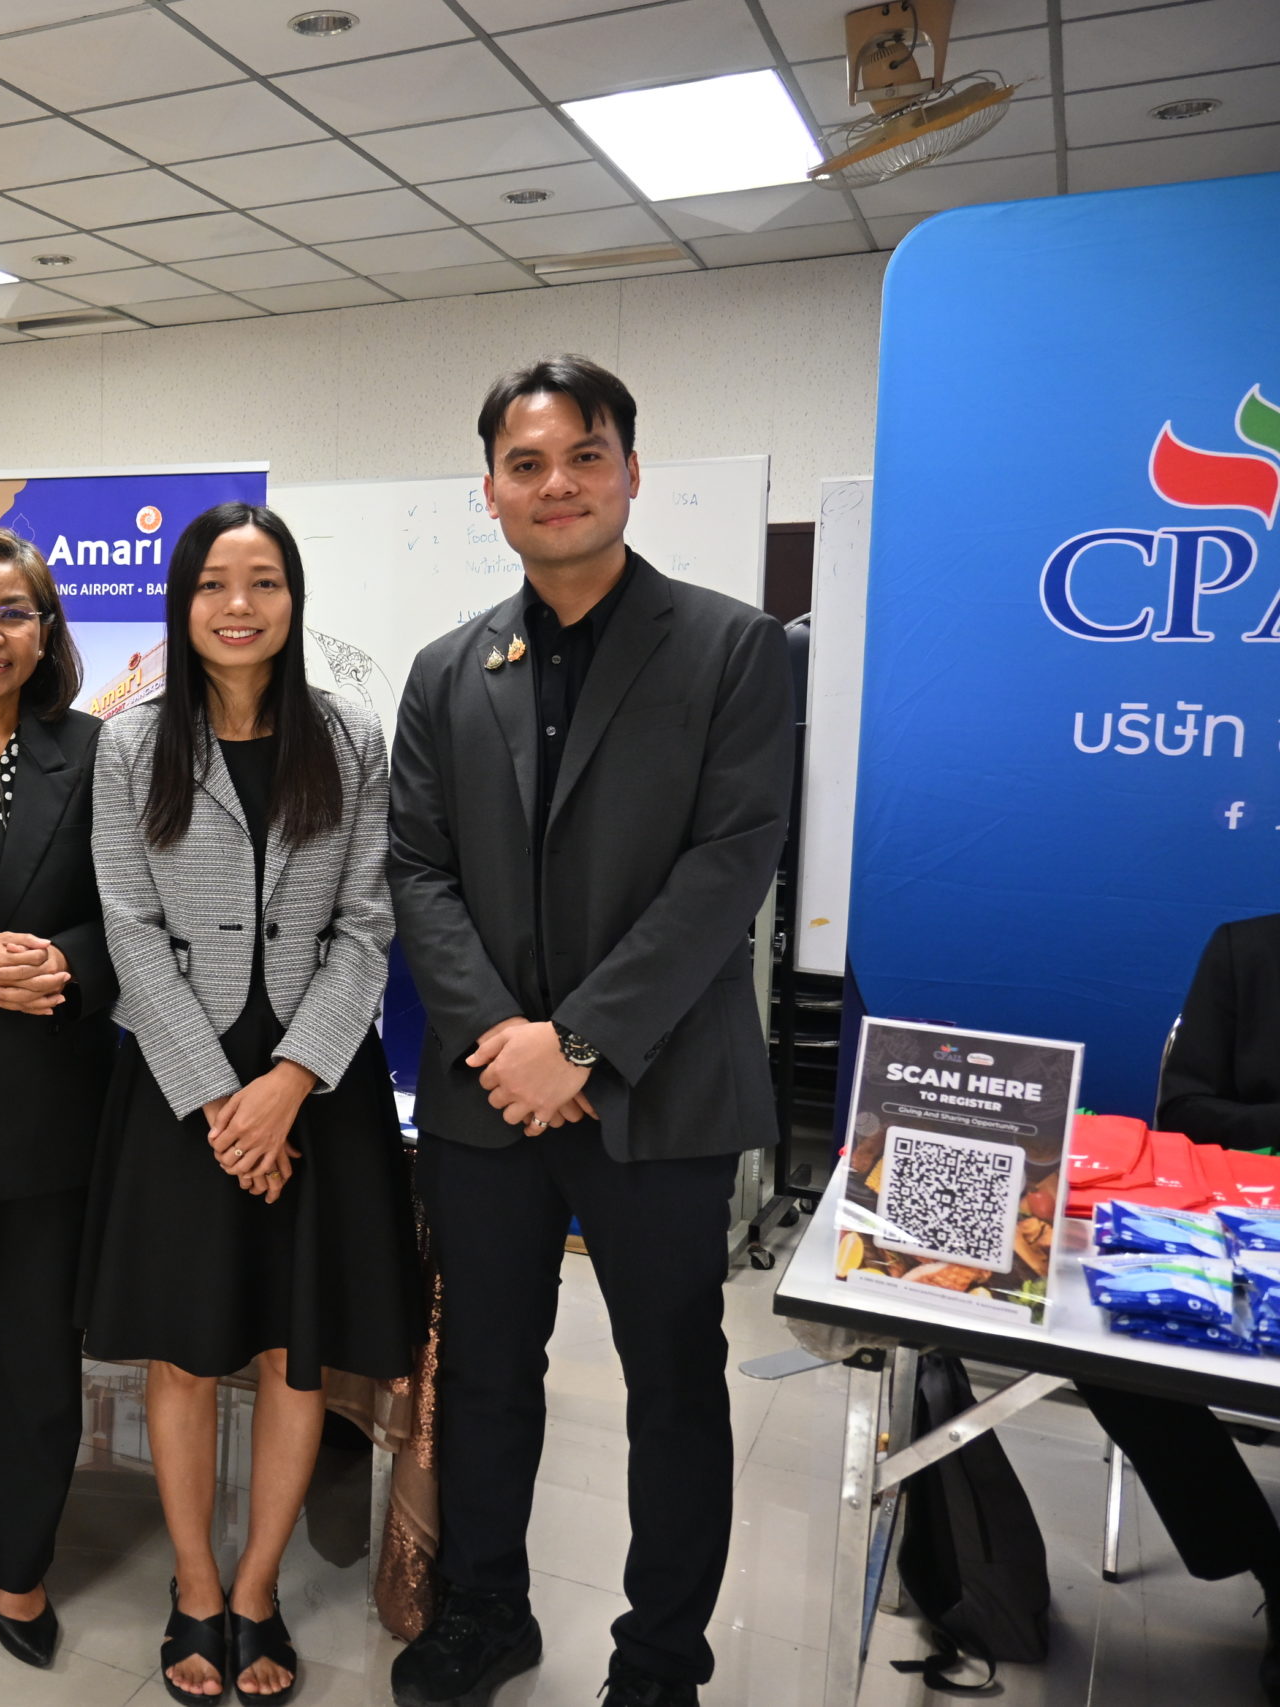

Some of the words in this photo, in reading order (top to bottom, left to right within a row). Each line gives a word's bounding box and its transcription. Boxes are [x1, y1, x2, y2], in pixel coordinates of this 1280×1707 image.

[466, 523, 499, 545] Food
[46, 534, 162, 565] Amari
[80, 583, 135, 596] AIRPORT
[1073, 700, 1245, 758] บริษัท
[886, 1062, 960, 1090] SCAN
[967, 1074, 1043, 1102] HERE
[919, 1090, 938, 1101] TO
[939, 1094, 1003, 1112] REGISTER
[898, 1106, 922, 1118] Giving
[923, 1110, 939, 1119] And
[940, 1113, 970, 1125] Sharing
[971, 1118, 1020, 1133] Opportunity
